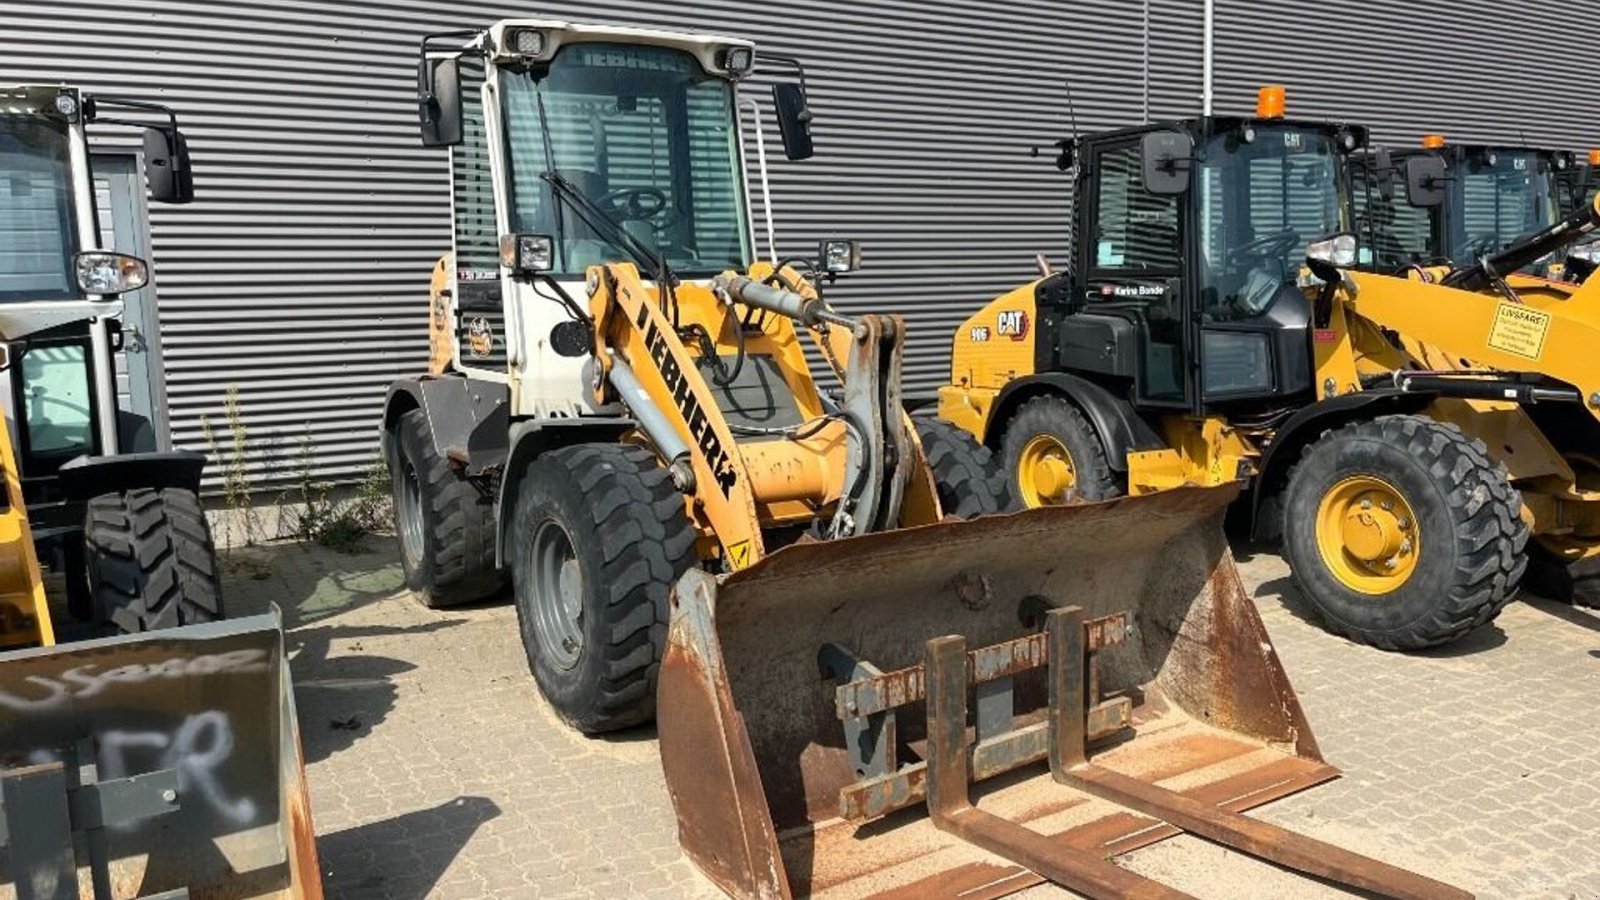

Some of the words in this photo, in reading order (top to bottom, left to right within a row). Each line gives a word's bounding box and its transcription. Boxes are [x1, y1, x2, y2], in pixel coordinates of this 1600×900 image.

[1283, 132, 1301, 147] CAT
[1139, 285, 1164, 295] Bonde
[998, 311, 1023, 335] CAT
